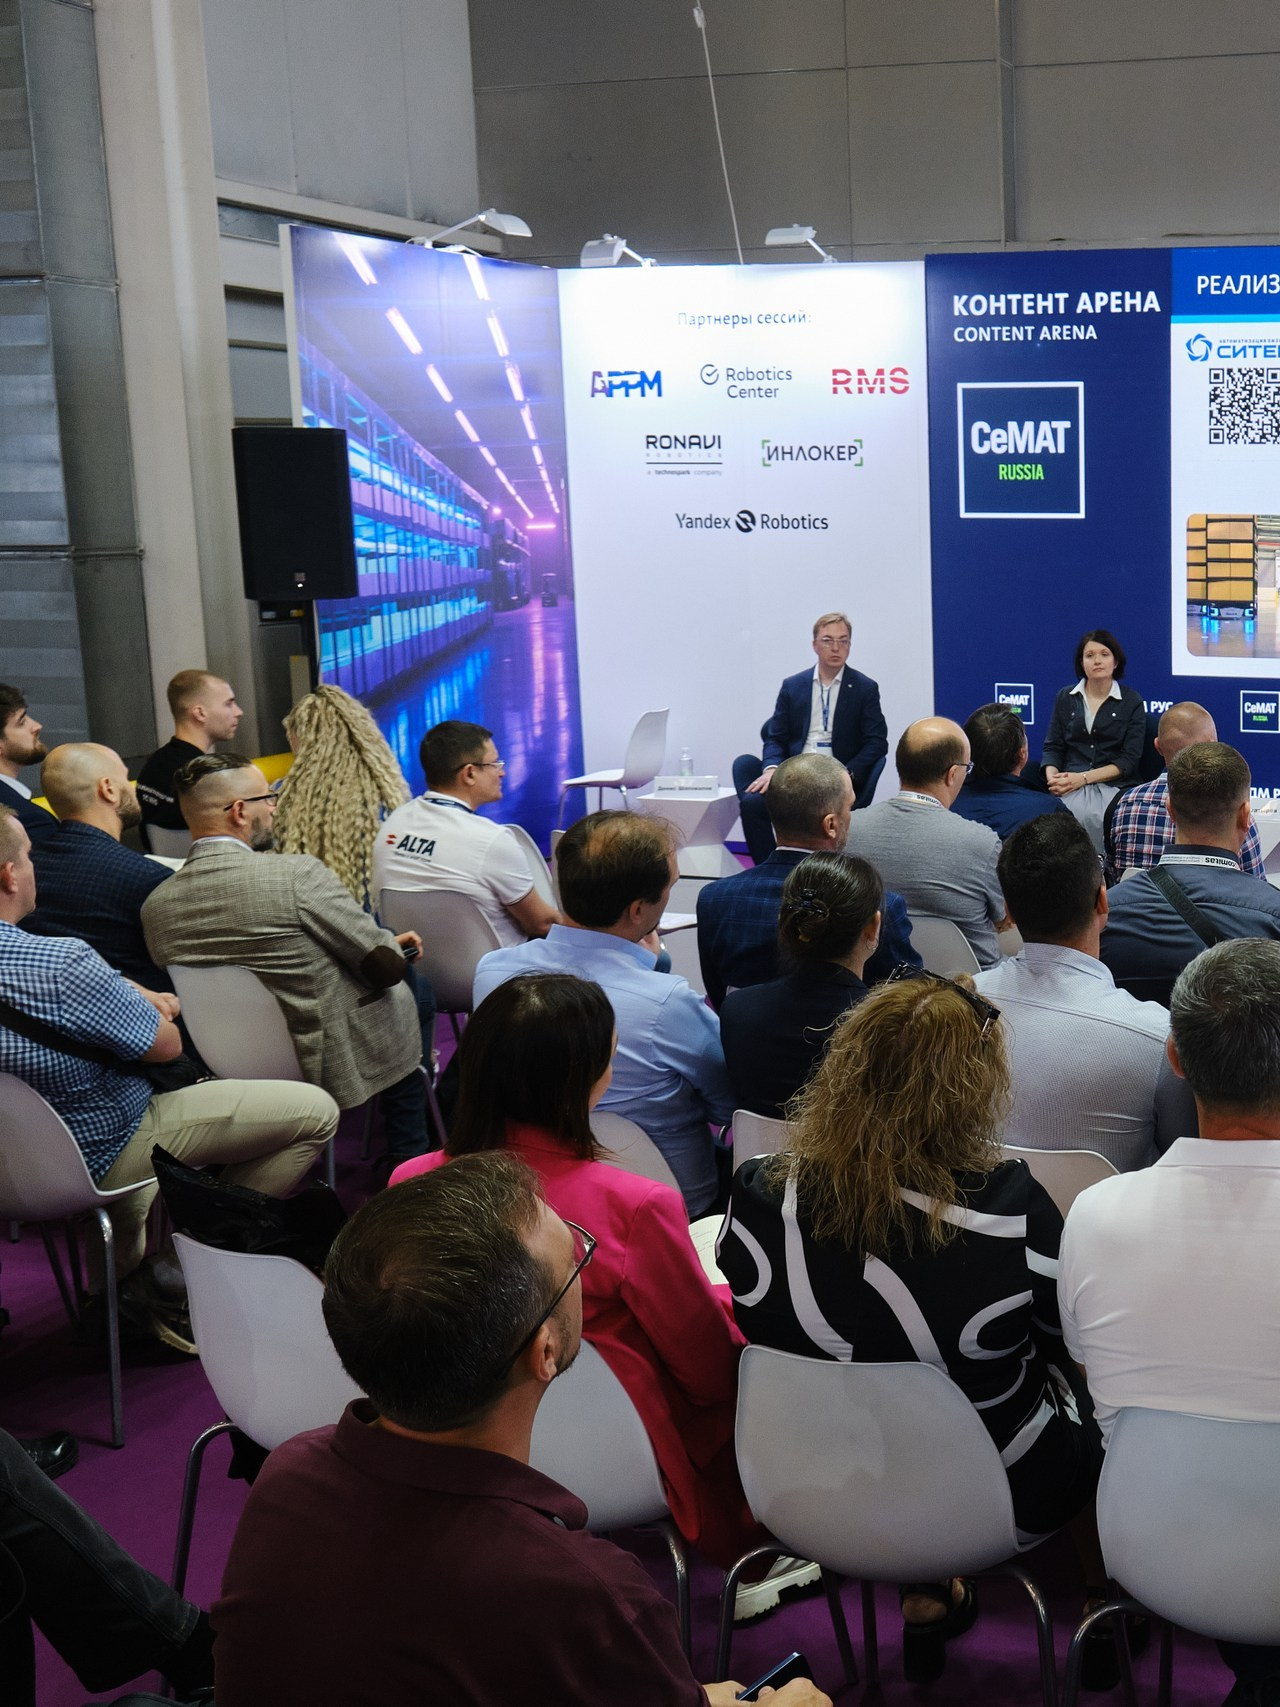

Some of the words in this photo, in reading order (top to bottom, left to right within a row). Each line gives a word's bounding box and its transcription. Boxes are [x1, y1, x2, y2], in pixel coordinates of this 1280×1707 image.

[952, 294, 1072, 316] КОНТЕНТ
[1076, 290, 1161, 314] АРЕНА
[677, 312, 752, 329] Партнеры
[757, 309, 812, 324] сессий:
[953, 325, 1034, 342] CONTENT
[1039, 324, 1098, 341] ARENA
[726, 366, 792, 382] Robotics
[831, 367, 910, 395] RMS
[727, 384, 779, 399] Center
[646, 435, 721, 450] RONAVI
[970, 420, 1071, 455] CeMAT
[766, 445, 858, 462] ИНЛОКЕР
[998, 463, 1044, 482] RUSSIA
[676, 512, 731, 529] Yandex
[761, 514, 829, 530] Robotics
[998, 694, 1030, 706] CeMAT
[1244, 702, 1277, 714] CeMAT
[397, 835, 436, 856] ALTA
